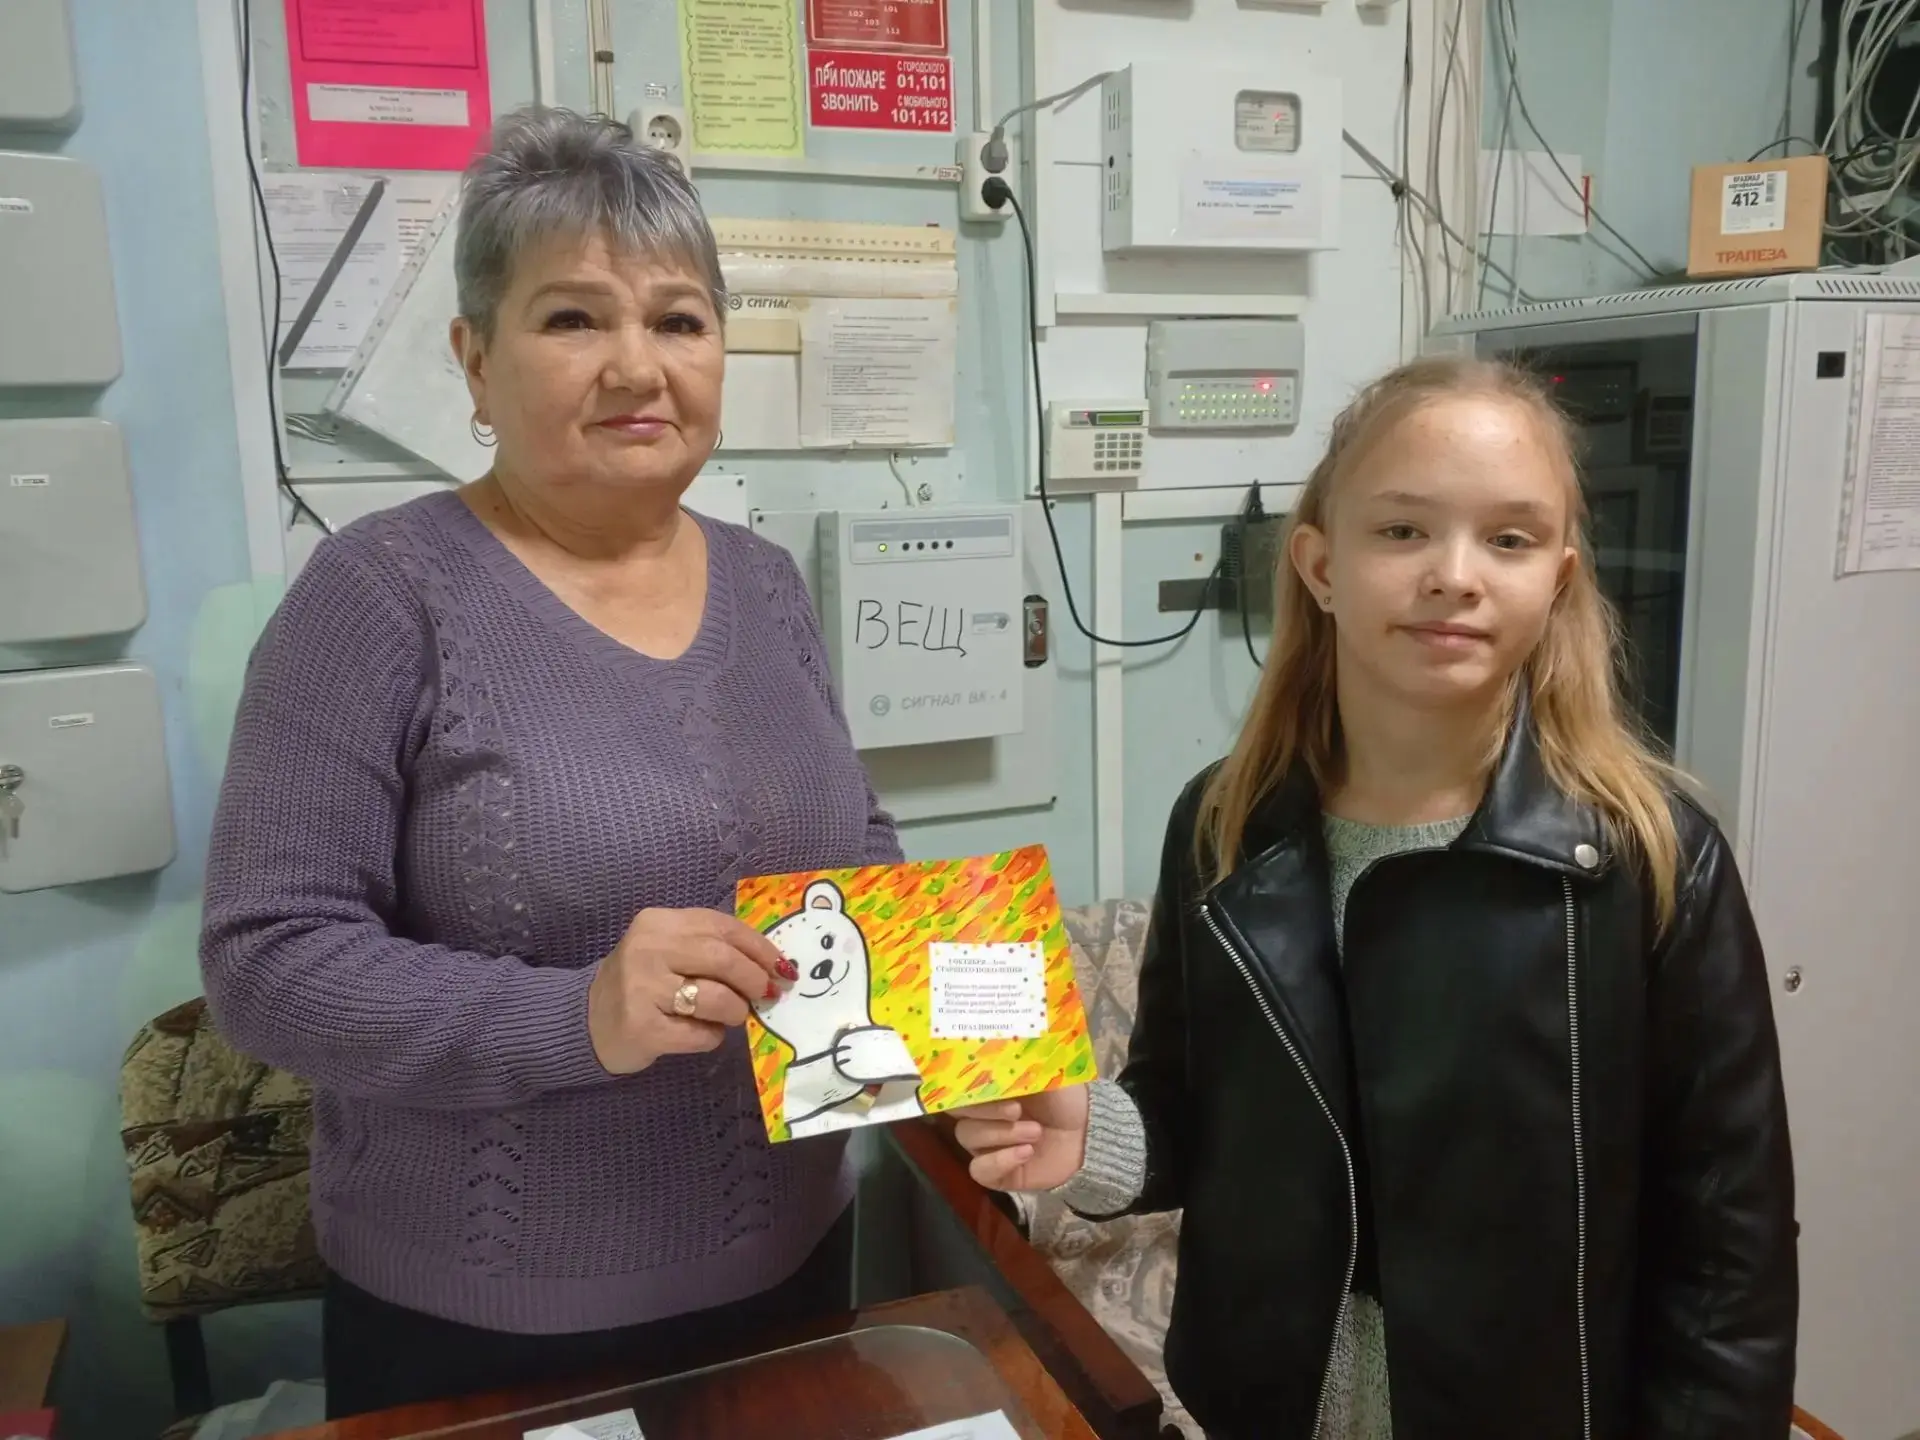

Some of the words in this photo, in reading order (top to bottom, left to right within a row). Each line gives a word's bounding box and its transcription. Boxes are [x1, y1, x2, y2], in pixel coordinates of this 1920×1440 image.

[897, 61, 902, 71] С
[903, 61, 945, 74] ГОРОДСКОГО
[815, 66, 838, 87] ПРИ
[840, 67, 887, 90] ПОЖАРЕ
[897, 75, 946, 91] 01,101
[821, 93, 879, 113] ЗВОНИТЬ
[897, 95, 902, 107] С
[903, 96, 948, 109] МОБИЛЬНОГО
[891, 109, 949, 126] 101,112
[1731, 191, 1760, 207] 412
[1715, 248, 1788, 265] ТРАПЕЗА
[855, 599, 968, 658] ВЕЩ
[902, 692, 961, 710] СИГНАЛ
[999, 688, 1008, 700] 4
